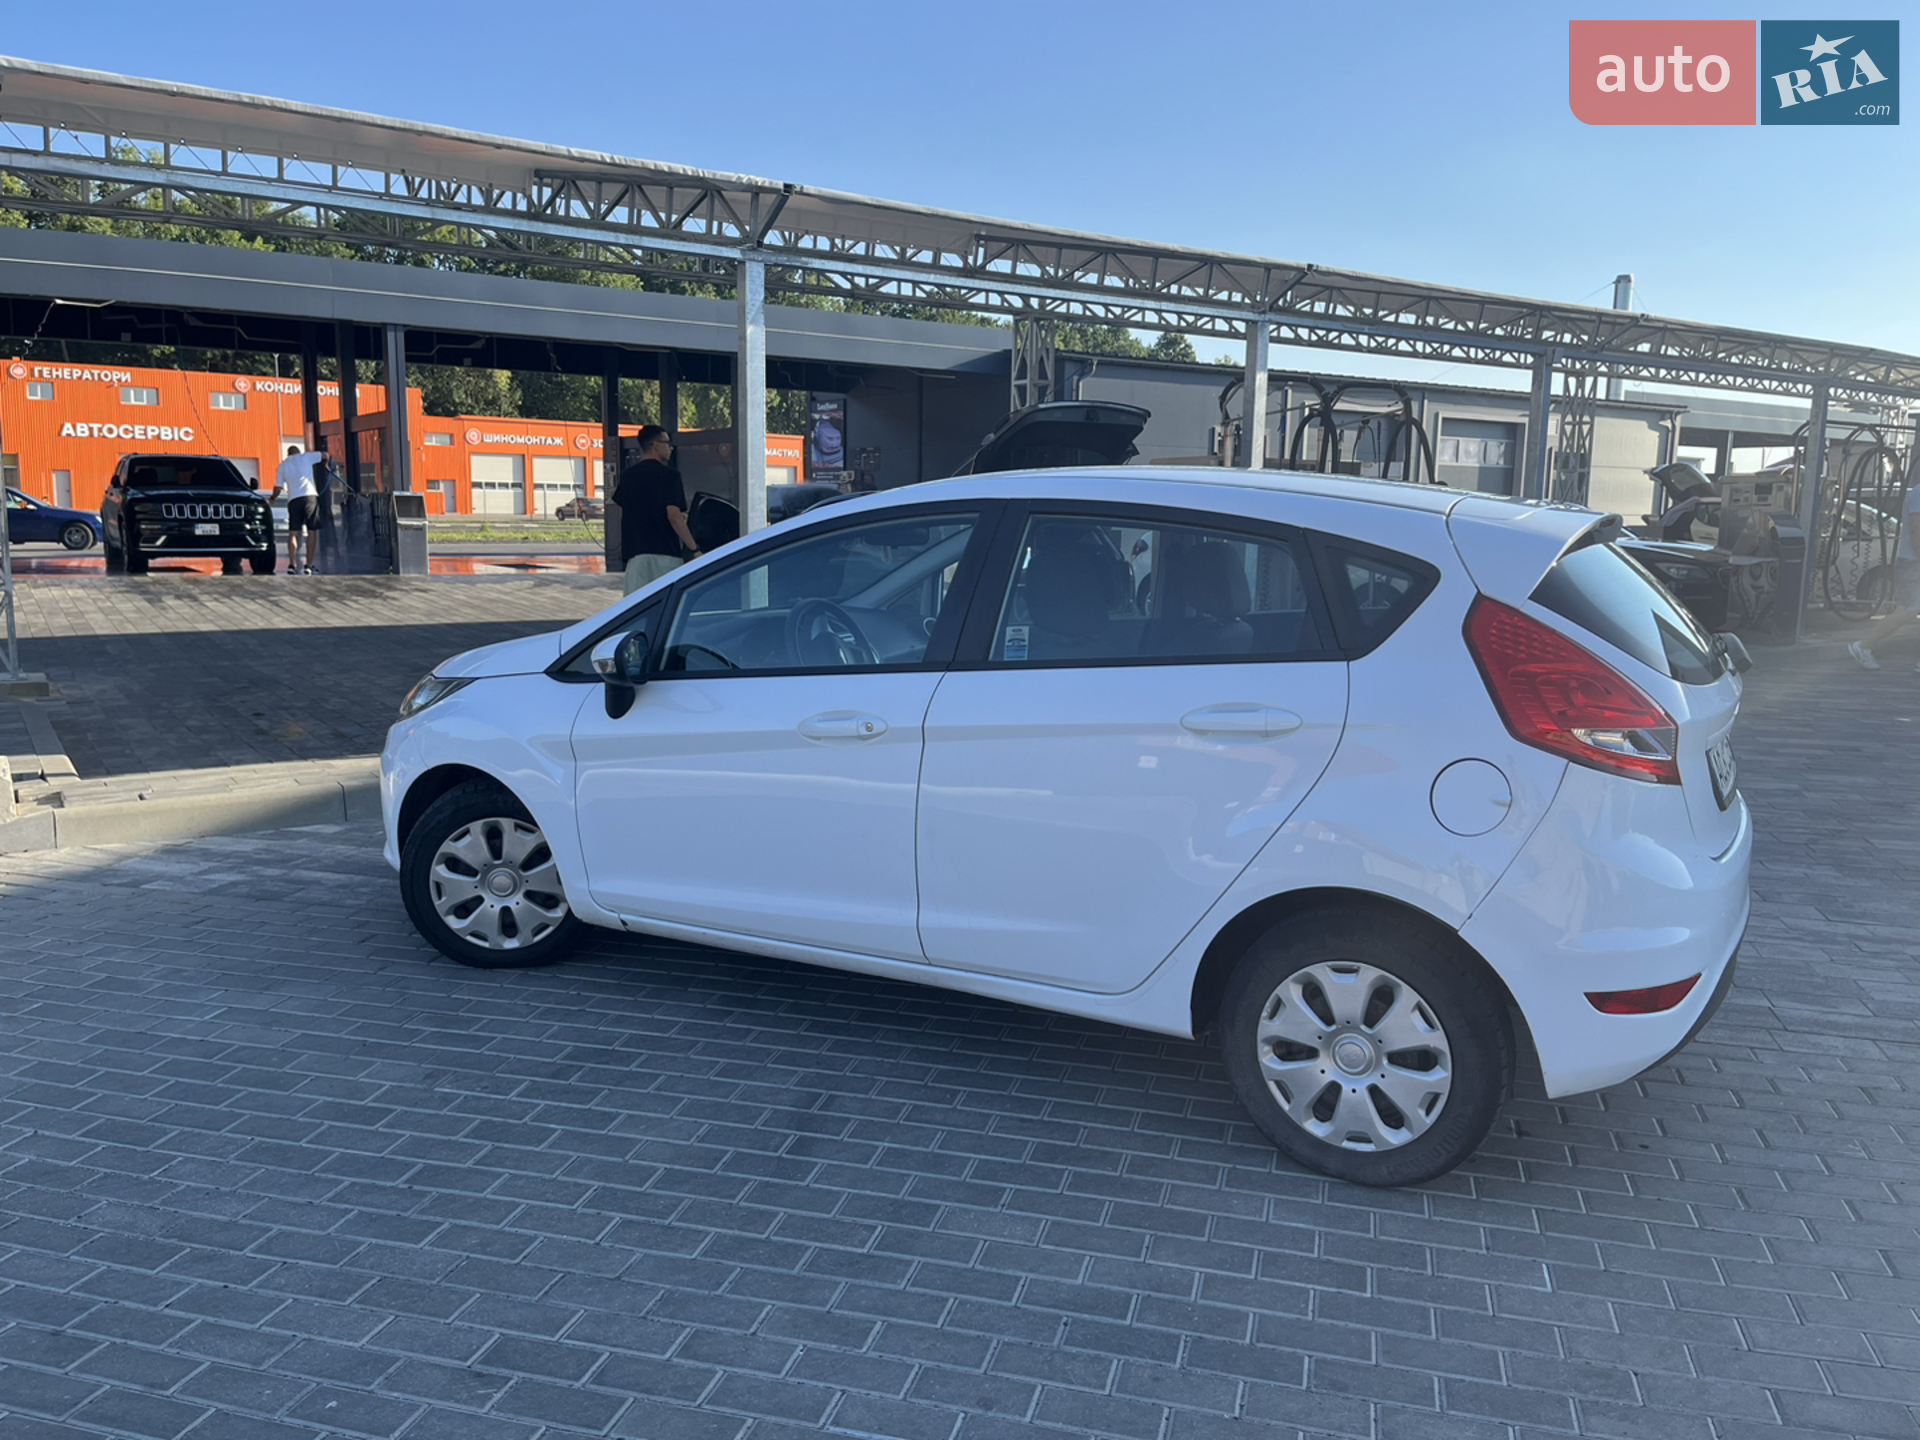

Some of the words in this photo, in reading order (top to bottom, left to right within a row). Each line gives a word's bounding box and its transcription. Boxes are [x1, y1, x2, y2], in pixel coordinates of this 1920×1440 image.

[33, 366, 131, 383] ГЕНЕРАТОРИ
[255, 381, 360, 398] КОНДИОН
[61, 422, 195, 442] АВТОСЕРВІС
[483, 433, 564, 446] ШИНОМОНТАЖ
